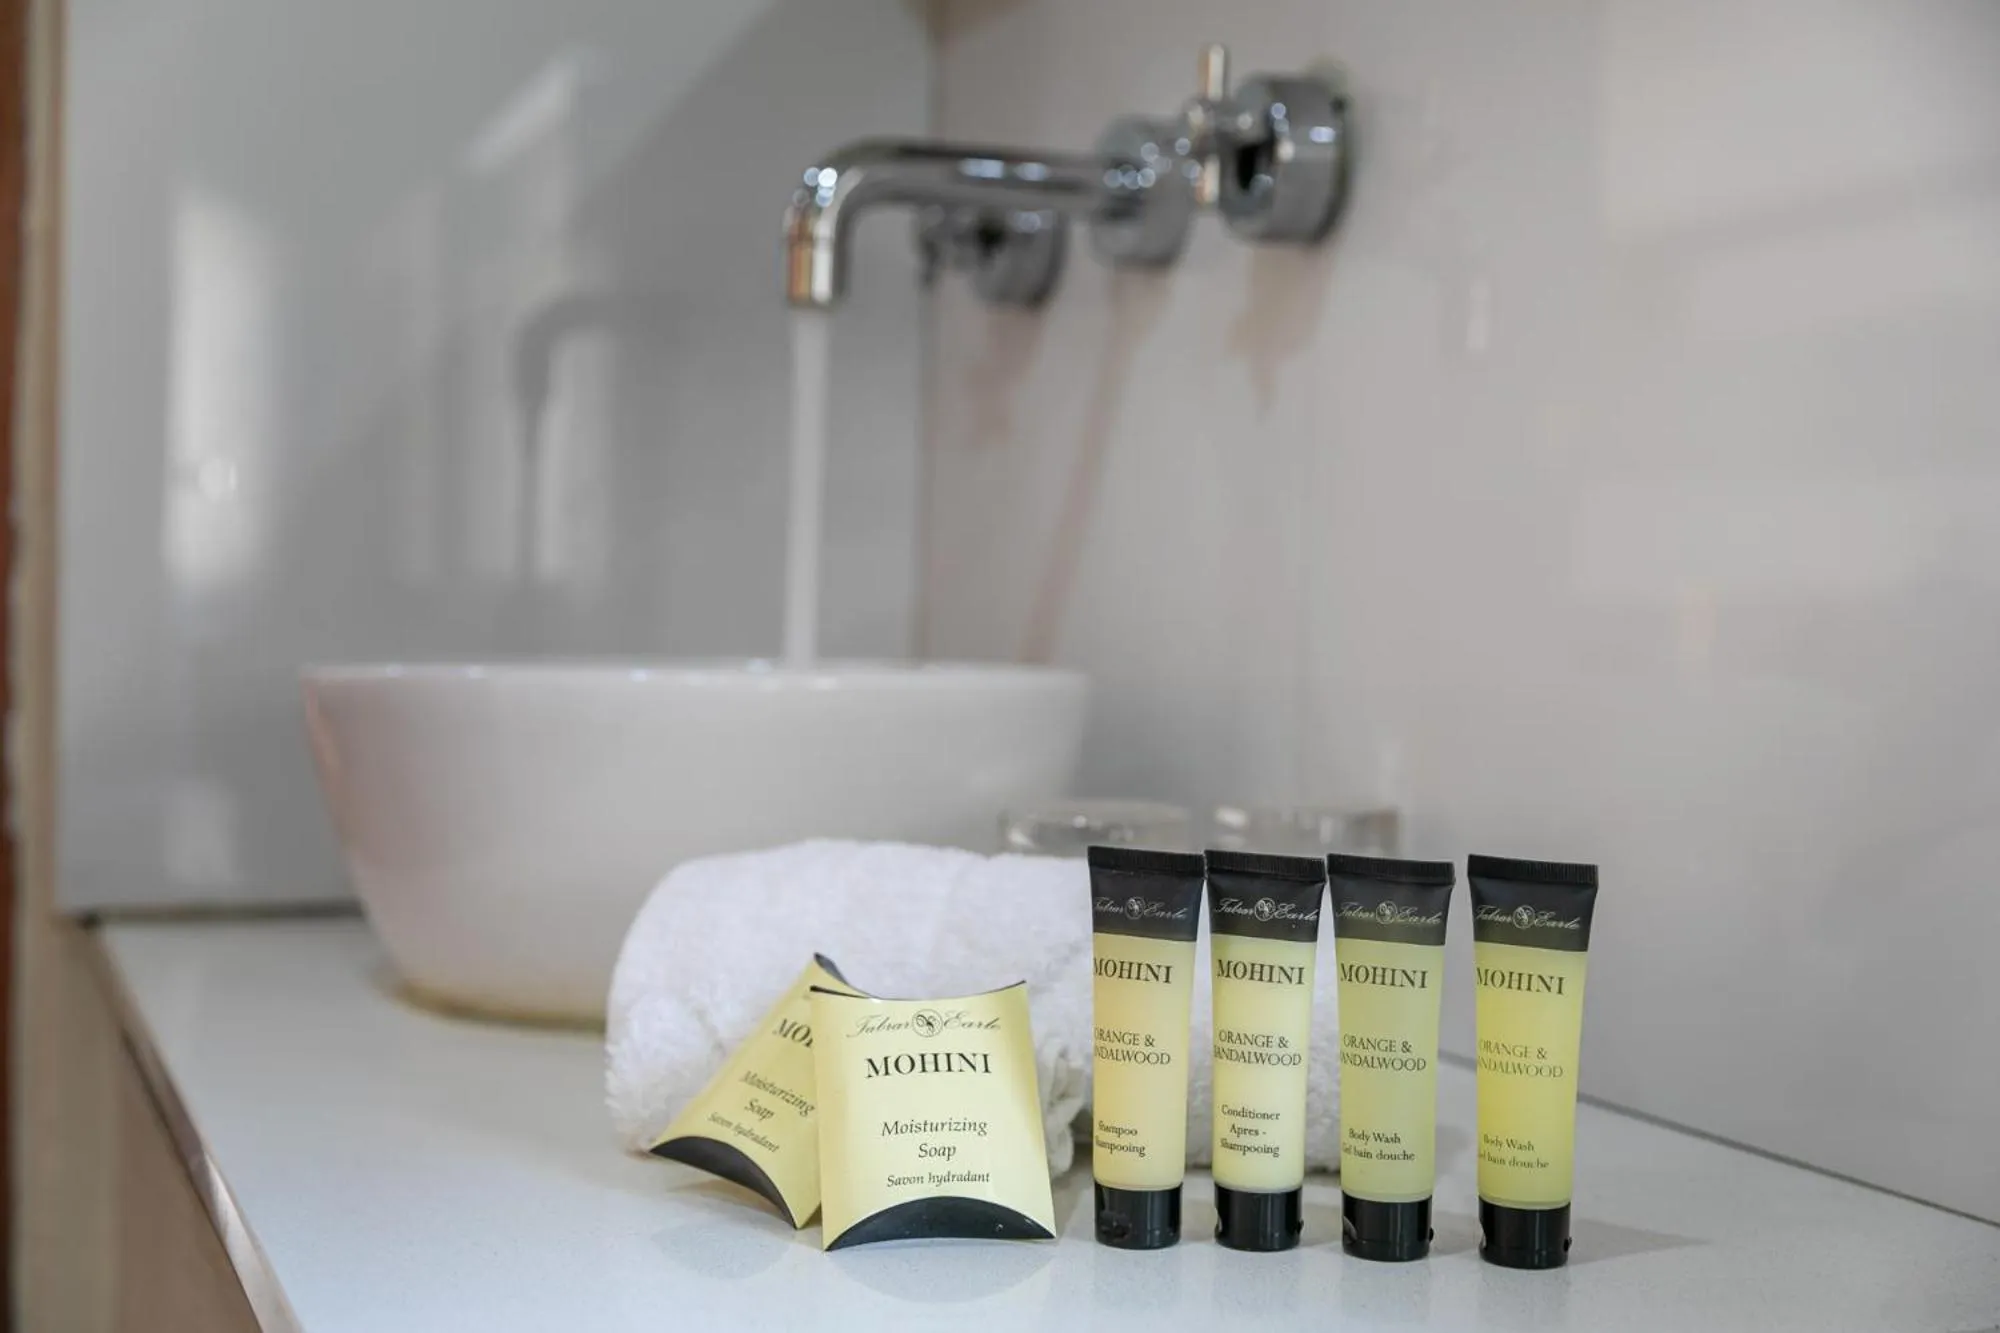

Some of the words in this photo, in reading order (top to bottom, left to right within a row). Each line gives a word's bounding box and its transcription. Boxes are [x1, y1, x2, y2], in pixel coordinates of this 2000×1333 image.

[1216, 958, 1305, 985] MOHINI
[1339, 962, 1428, 989] MOHINI
[1476, 966, 1567, 995] MOHINI
[1143, 1033, 1155, 1048] &
[1218, 1028, 1274, 1049] ORANGE
[1277, 1035, 1291, 1049] &
[1343, 1033, 1398, 1053] ORANGE
[1400, 1040, 1413, 1054] &
[1535, 1047, 1548, 1061] &
[864, 1051, 992, 1078] MOHINI
[739, 1070, 816, 1118] Moisturizing
[743, 1098, 776, 1122] Soap
[1220, 1103, 1281, 1121] Conditioner
[881, 1116, 989, 1137] Moisturizing
[1098, 1120, 1138, 1138] Shampoo
[1229, 1123, 1260, 1138] Apres
[1348, 1127, 1371, 1146] Body
[1372, 1131, 1402, 1145] Wash
[917, 1142, 957, 1161] Soap
[1095, 1135, 1146, 1158] hampooing
[1220, 1137, 1281, 1159] Shampooing
[1353, 1145, 1374, 1160] bain
[1375, 1149, 1416, 1161] douche
[1483, 1133, 1503, 1152] Body
[1505, 1137, 1536, 1153] Wash
[1487, 1151, 1507, 1165] bain
[1508, 1155, 1551, 1169] douche
[886, 1174, 925, 1188] Savon
[927, 1169, 991, 1187] hydradant
